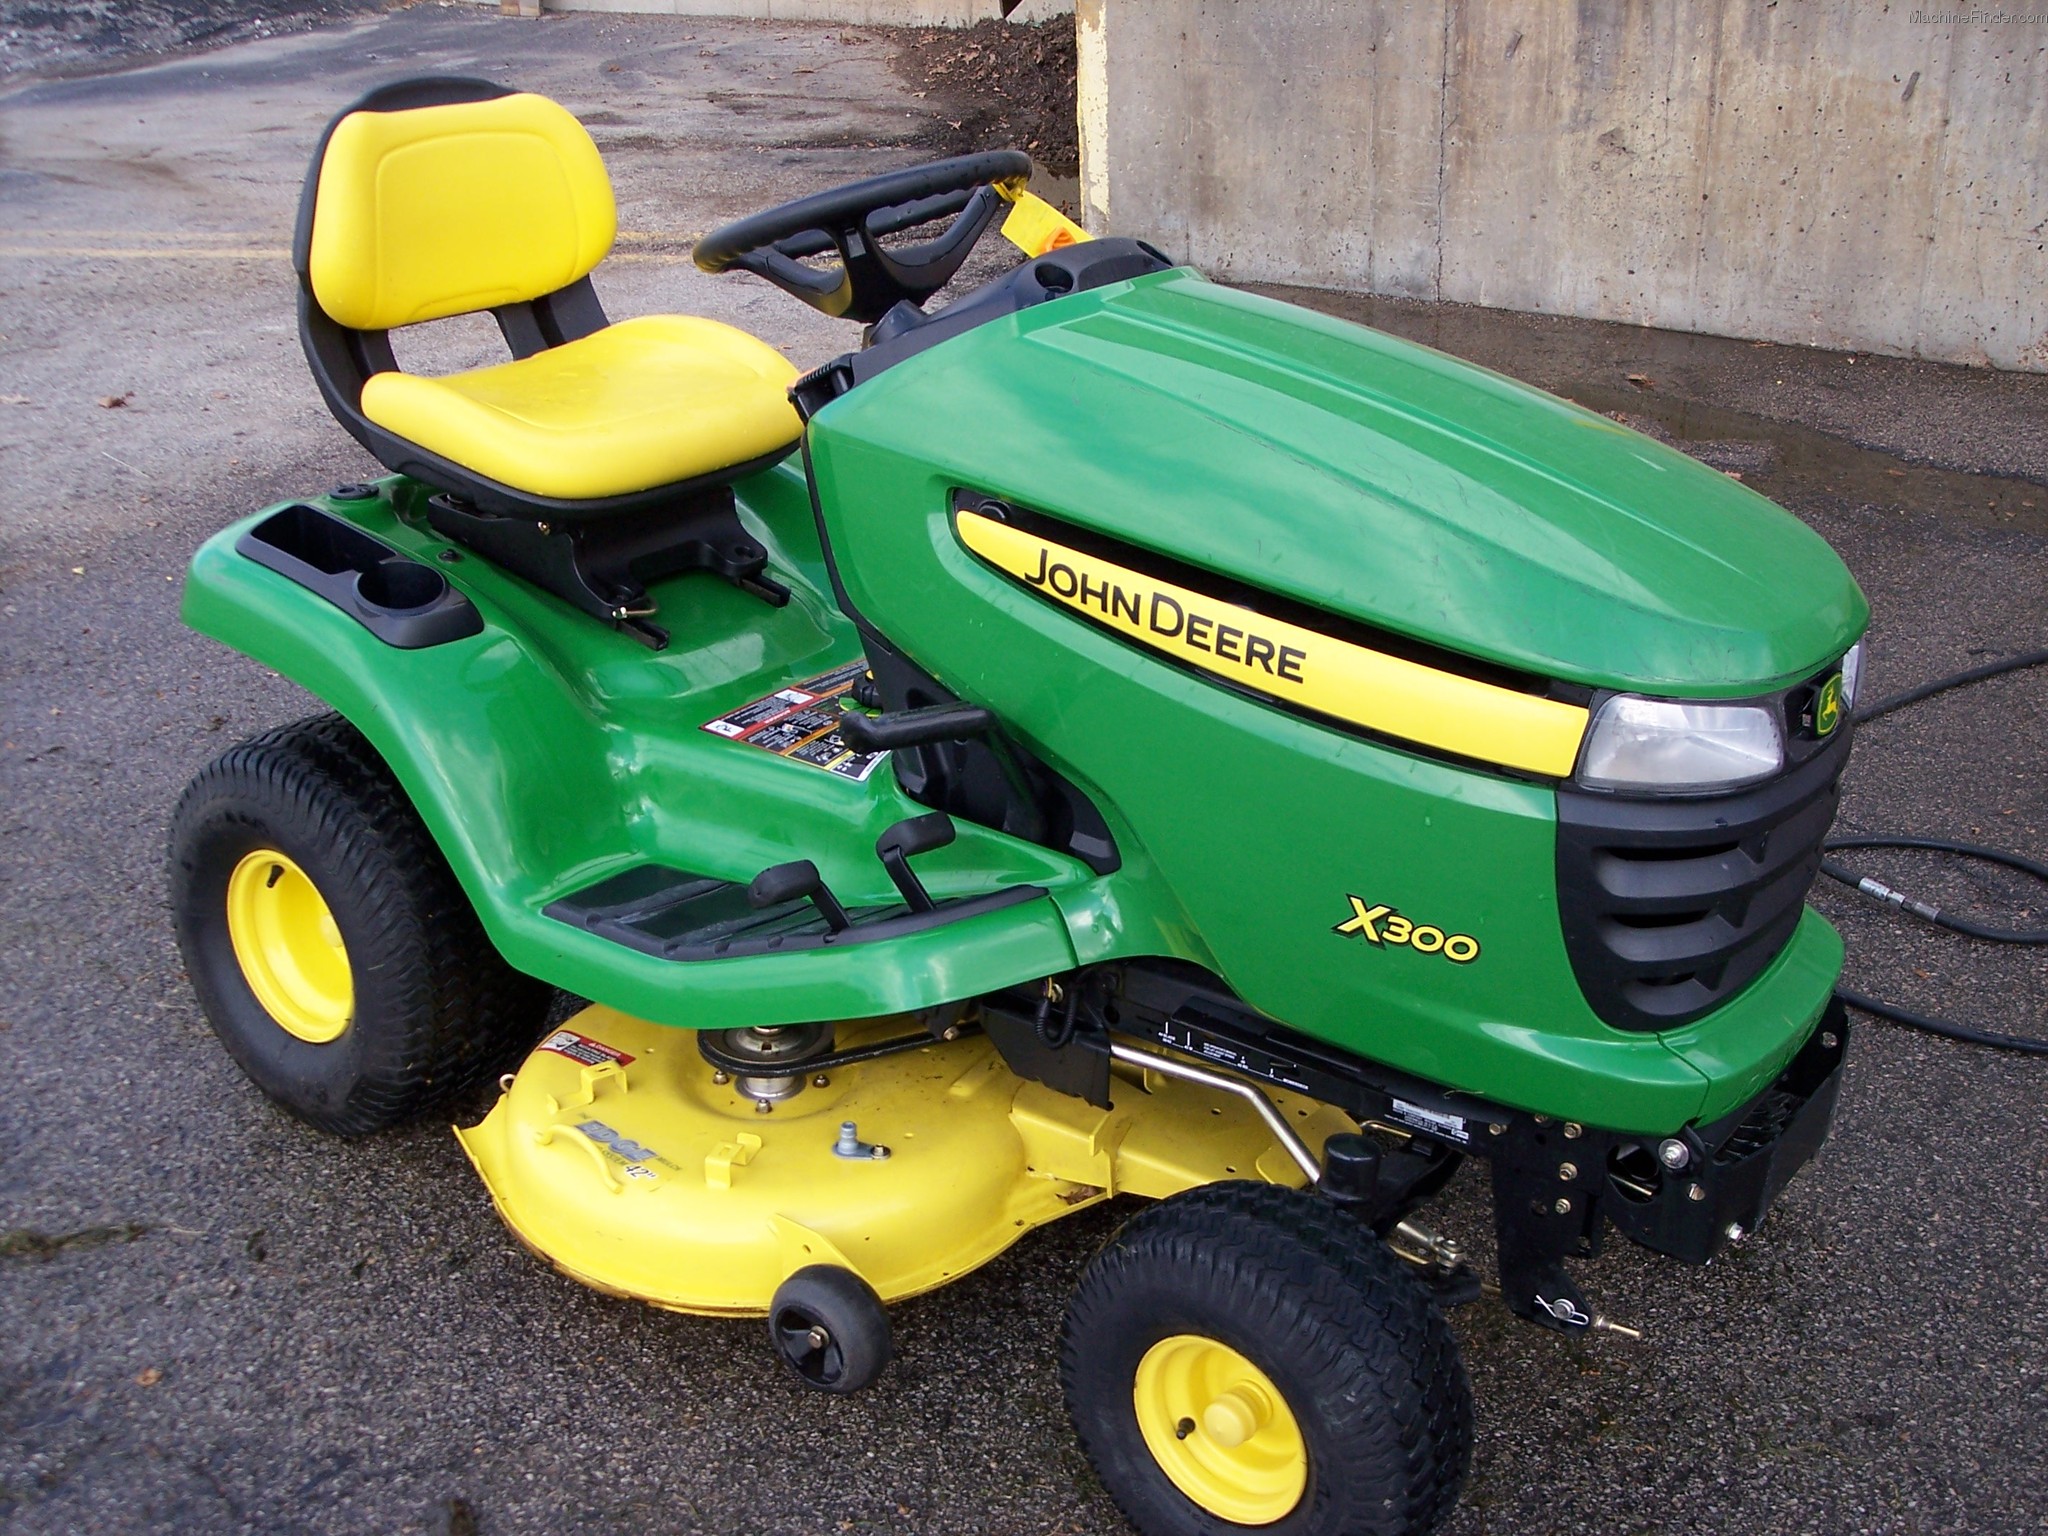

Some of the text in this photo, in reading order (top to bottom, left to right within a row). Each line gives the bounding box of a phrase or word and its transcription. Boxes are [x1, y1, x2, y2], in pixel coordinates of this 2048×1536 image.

[1024, 548, 1307, 684] JOHN DEERE
[1331, 893, 1481, 966] X300
[625, 1165, 656, 1178] 42"
